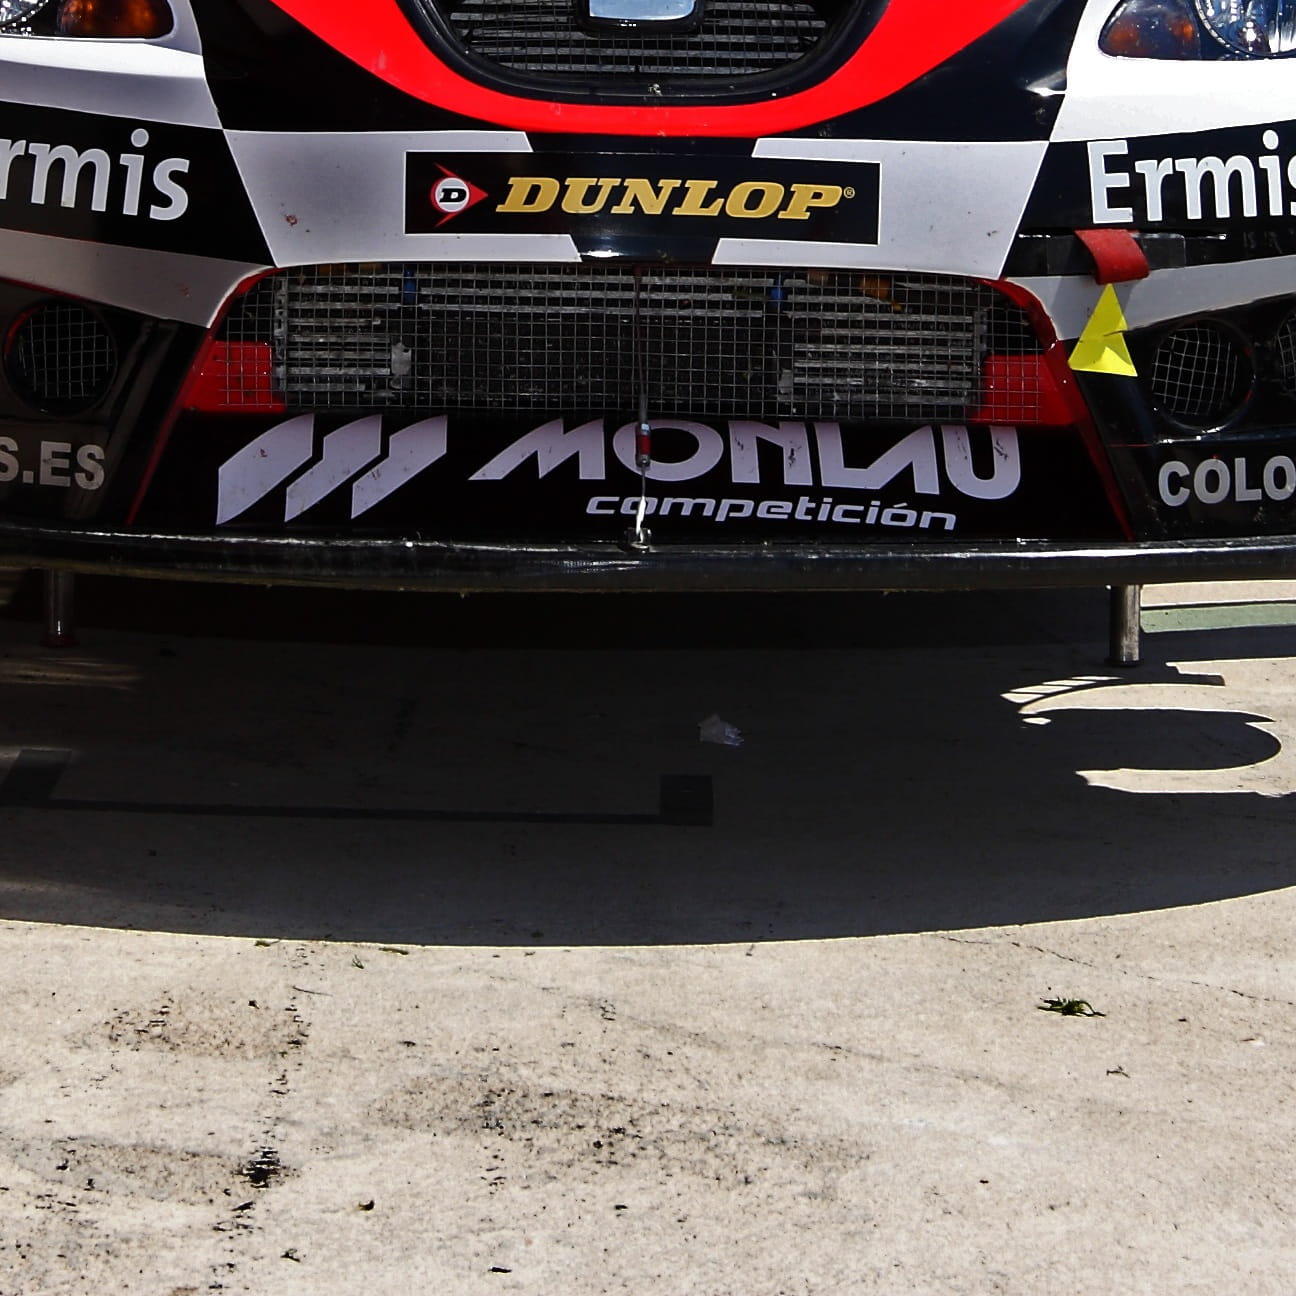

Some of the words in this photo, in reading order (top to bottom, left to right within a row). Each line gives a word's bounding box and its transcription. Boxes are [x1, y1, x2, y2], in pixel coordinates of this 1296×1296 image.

[495, 175, 845, 221] DUNLOP
[467, 417, 1021, 501] MONLAU
[585, 494, 958, 532] competición
